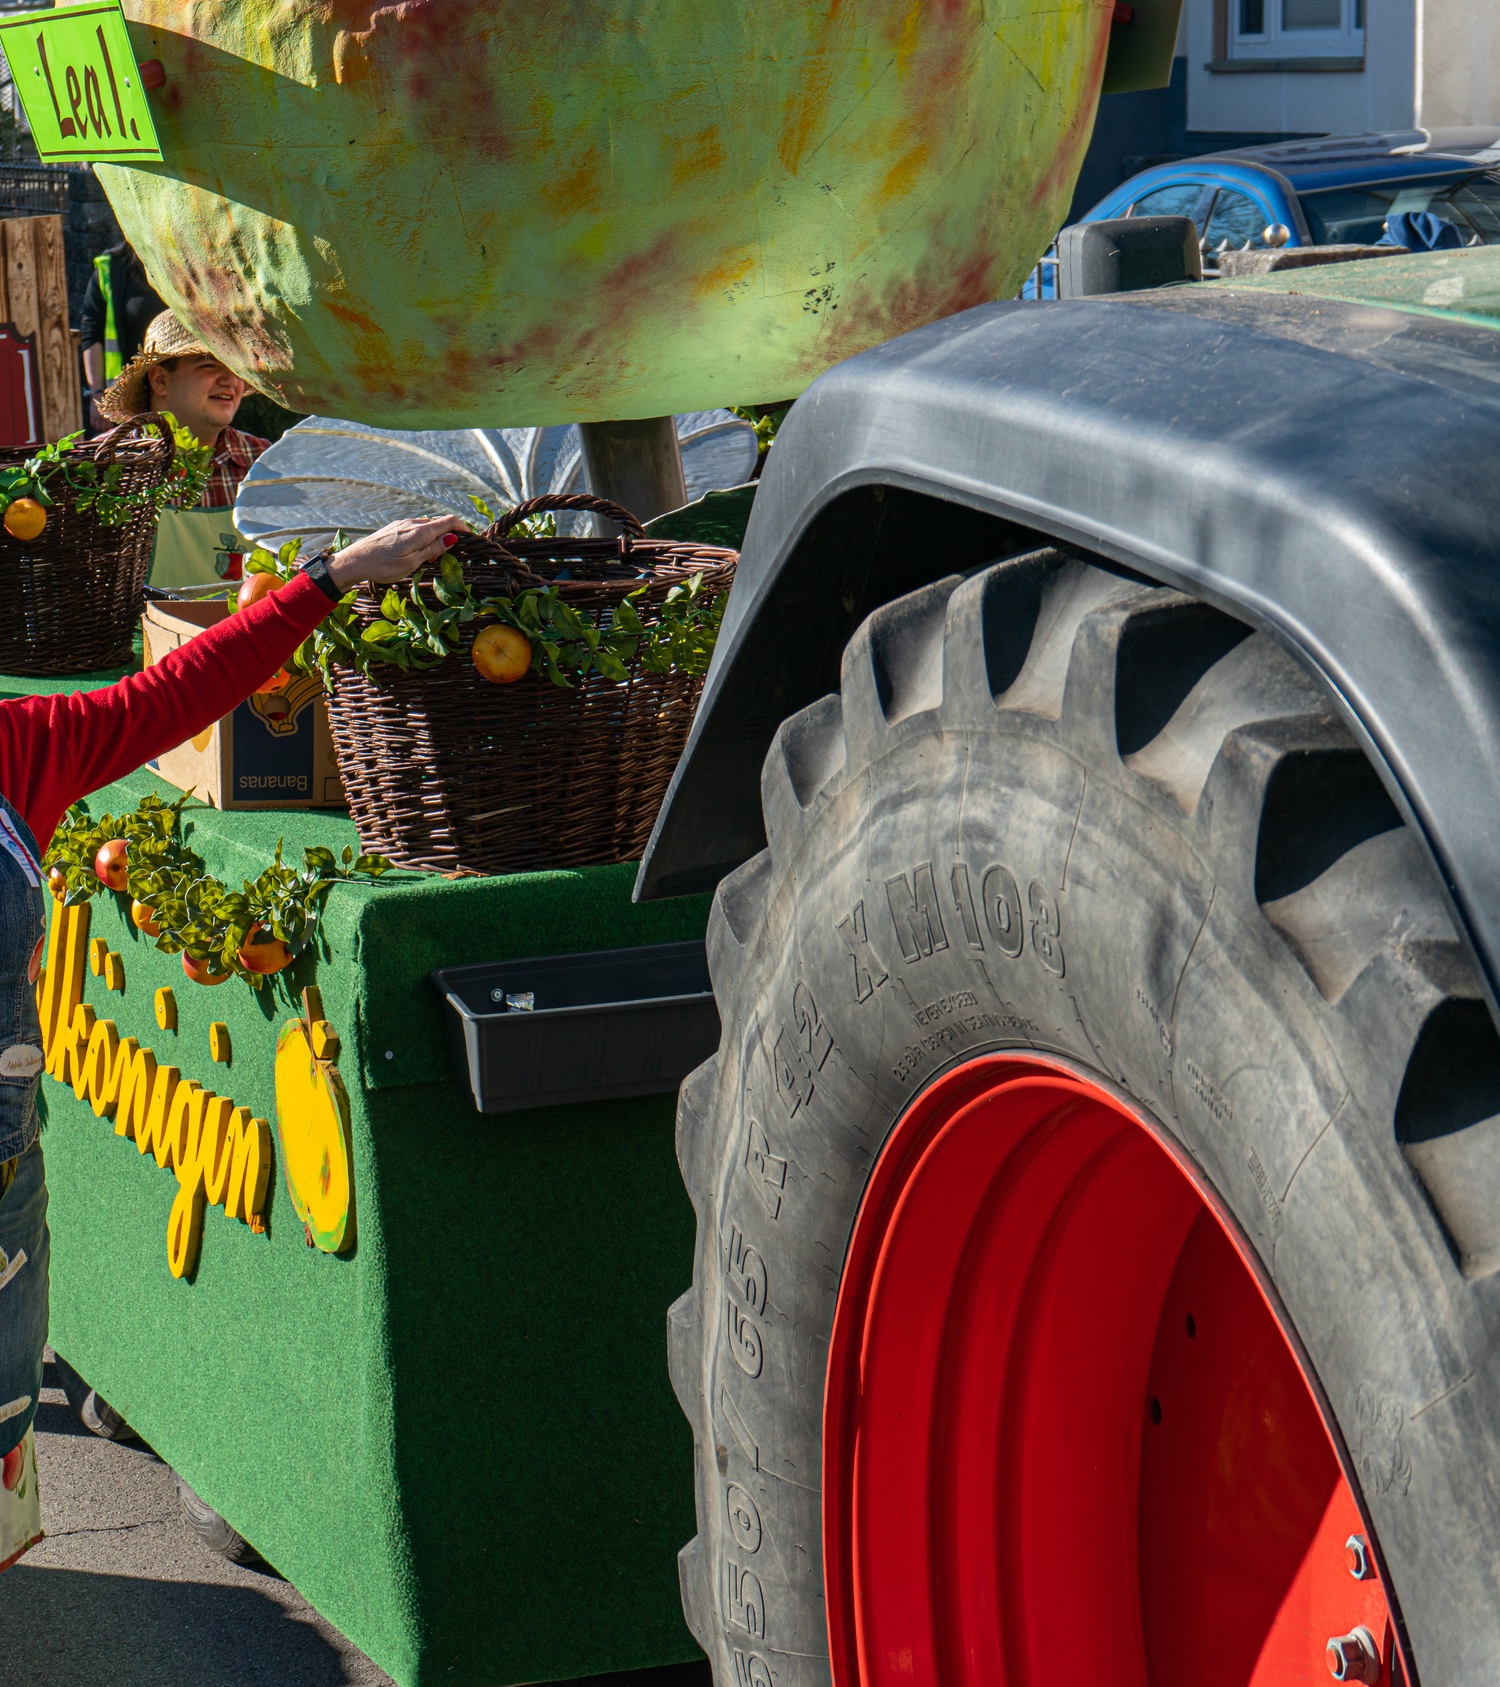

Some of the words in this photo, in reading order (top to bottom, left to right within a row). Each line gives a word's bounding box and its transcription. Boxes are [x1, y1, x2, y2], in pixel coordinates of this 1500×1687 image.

[239, 775, 308, 791] Bananas
[744, 1116, 788, 1222] R
[773, 977, 834, 1119] 42
